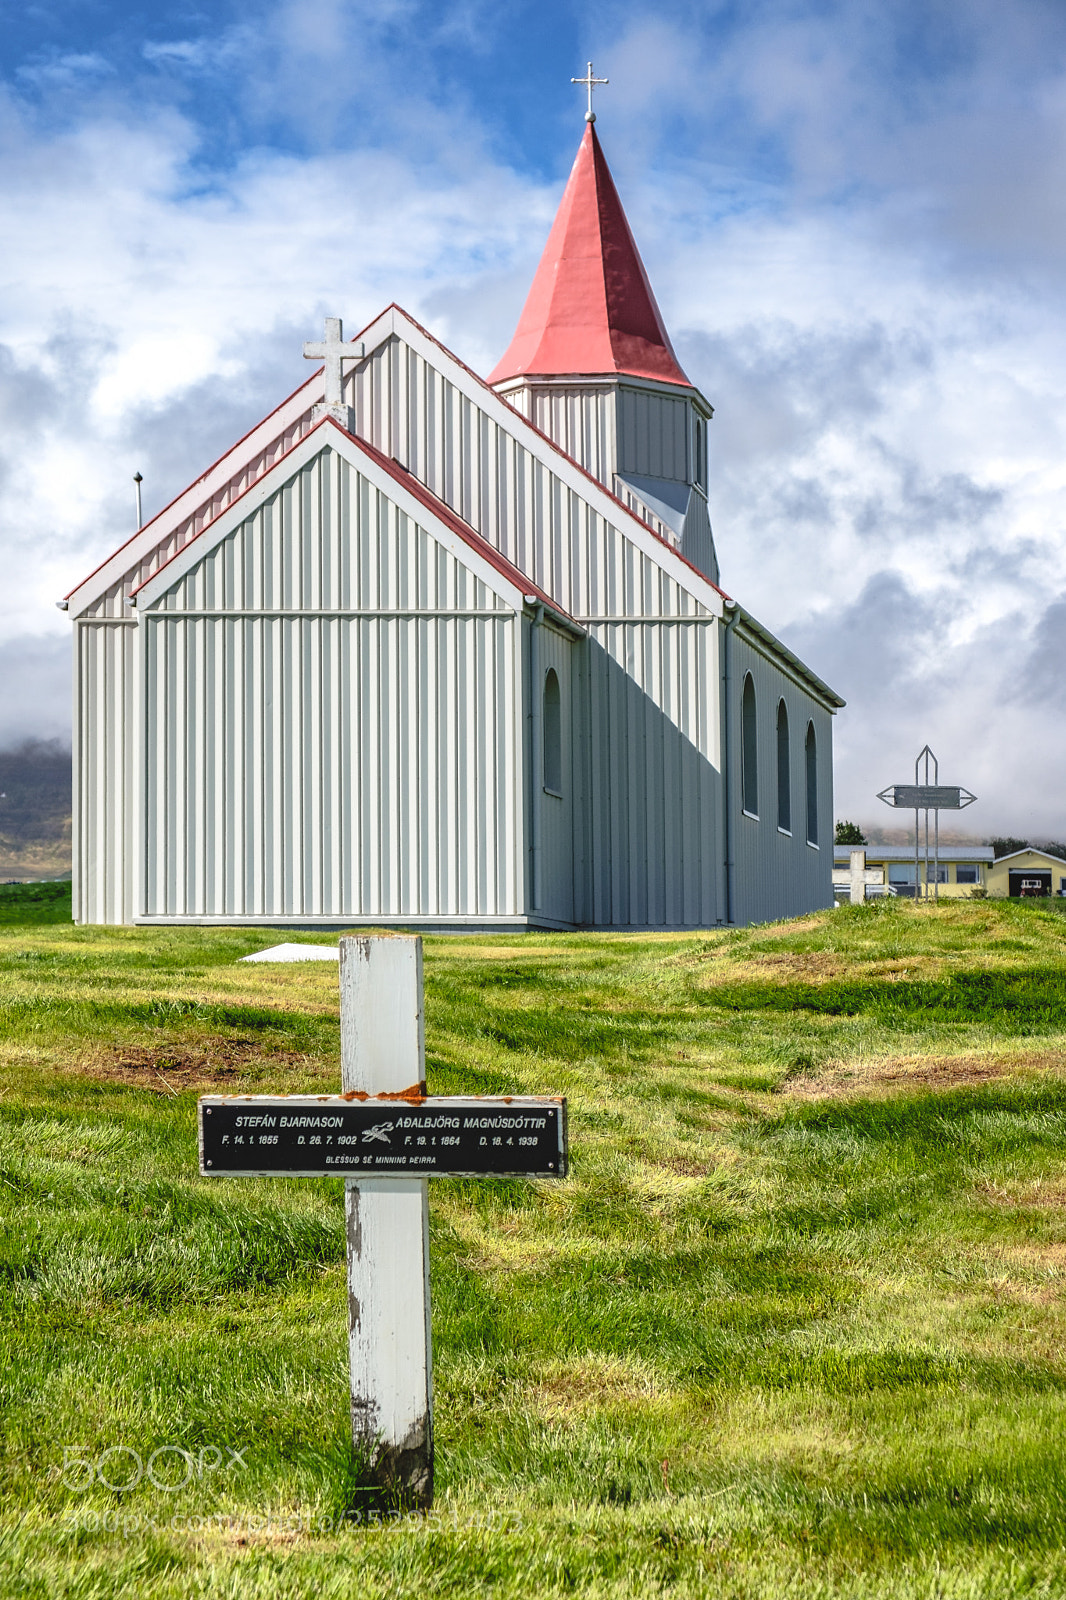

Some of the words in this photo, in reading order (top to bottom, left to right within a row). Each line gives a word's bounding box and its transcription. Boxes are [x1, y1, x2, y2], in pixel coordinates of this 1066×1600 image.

[235, 1114, 276, 1127] STEFÁN
[280, 1117, 344, 1128] BJARNASON
[395, 1115, 460, 1129] AÐALBJÖRG
[463, 1115, 547, 1129] MAGNÚSDÓTTIR
[221, 1135, 230, 1145] F.
[234, 1135, 245, 1145] 14.
[259, 1135, 279, 1145] 1855
[297, 1135, 306, 1145] D.
[326, 1135, 333, 1145] 7.
[337, 1135, 357, 1145] 1902
[404, 1136, 413, 1146] F.
[416, 1136, 427, 1146] 19.
[441, 1136, 461, 1146] 1864
[479, 1136, 488, 1146] D.
[506, 1136, 514, 1146] 4.
[518, 1136, 539, 1146] 1938
[375, 1156, 407, 1164] MINNING
